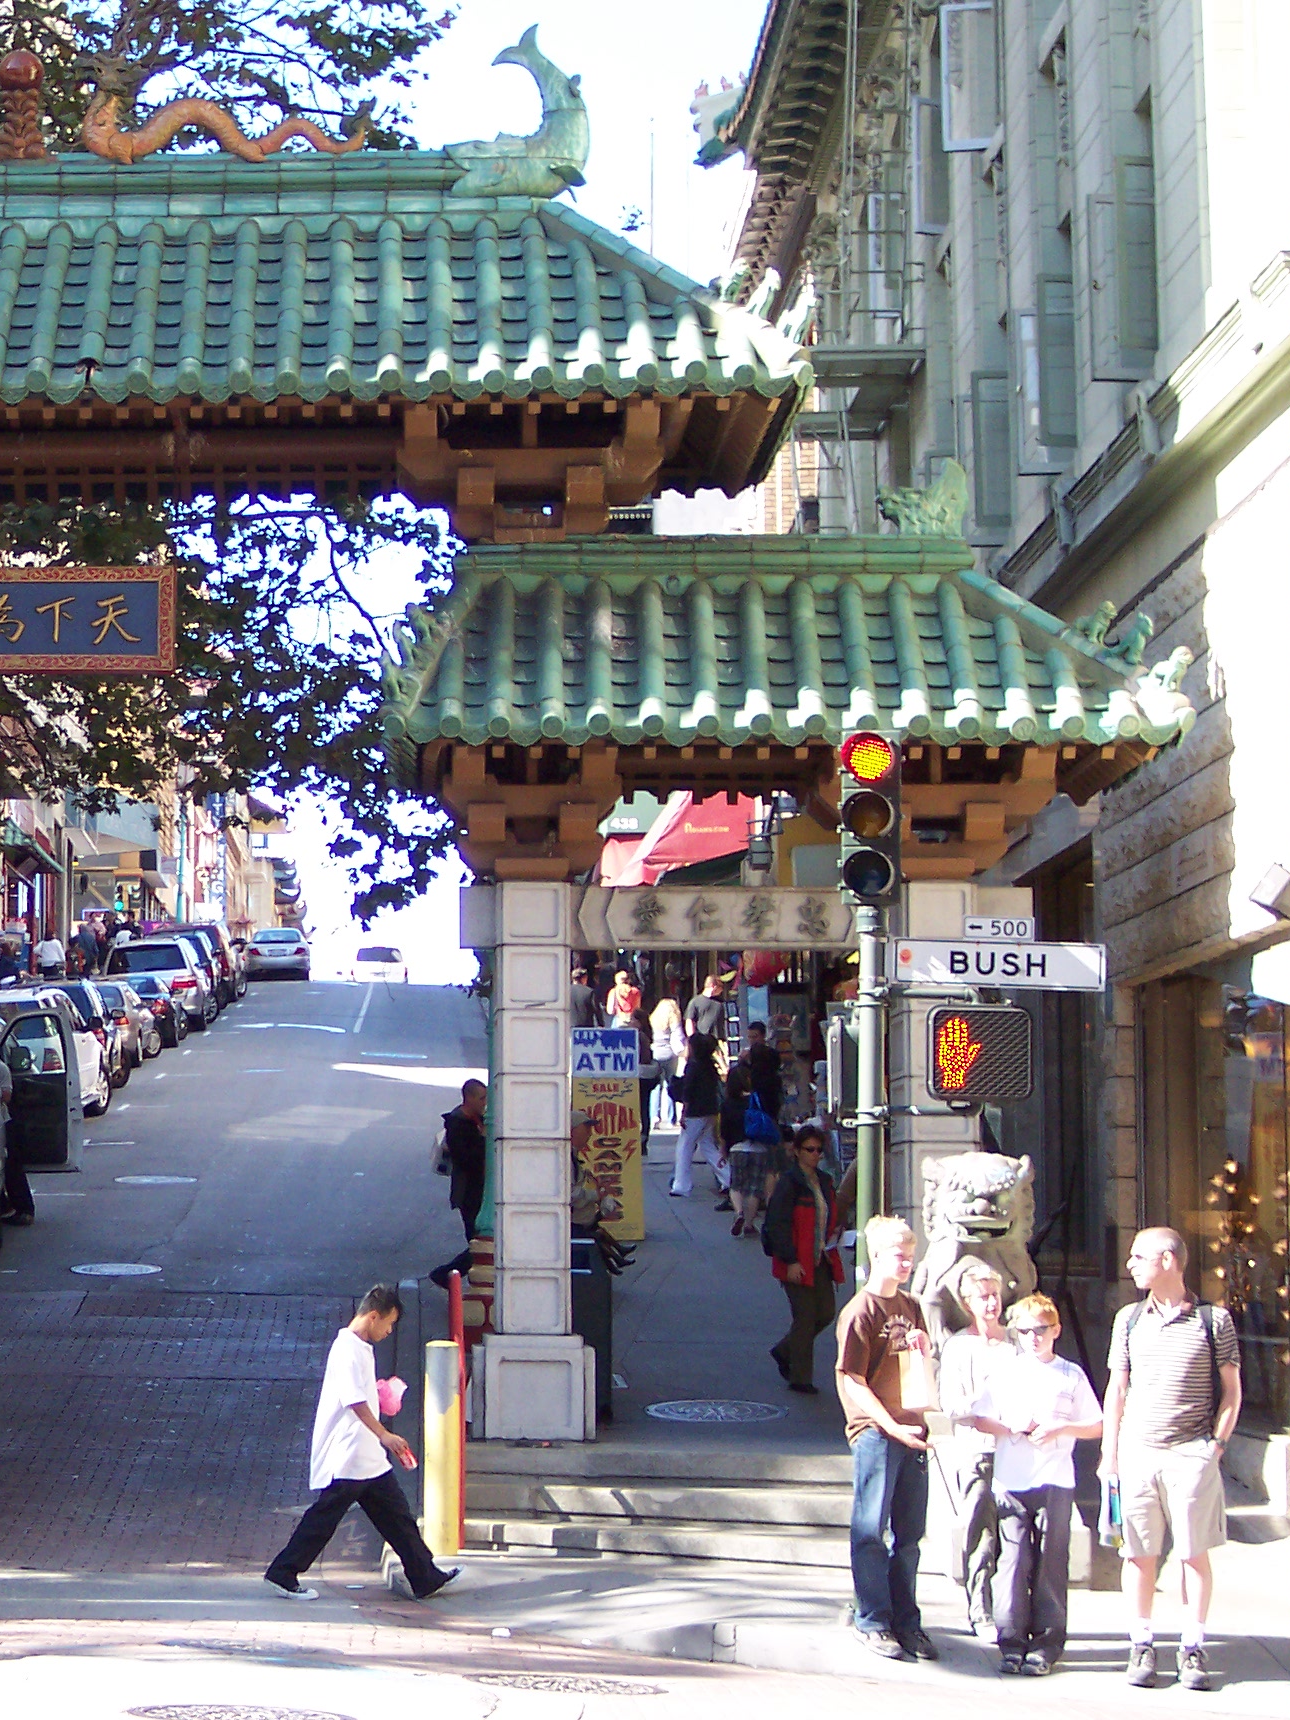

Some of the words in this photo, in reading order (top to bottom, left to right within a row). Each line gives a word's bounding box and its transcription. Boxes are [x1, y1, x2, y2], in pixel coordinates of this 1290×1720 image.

[990, 920, 1028, 937] 500
[949, 950, 1047, 978] BUSH
[576, 1052, 634, 1072] ATM
[592, 1082, 620, 1093] SALE
[579, 1101, 638, 1136] IGITAL
